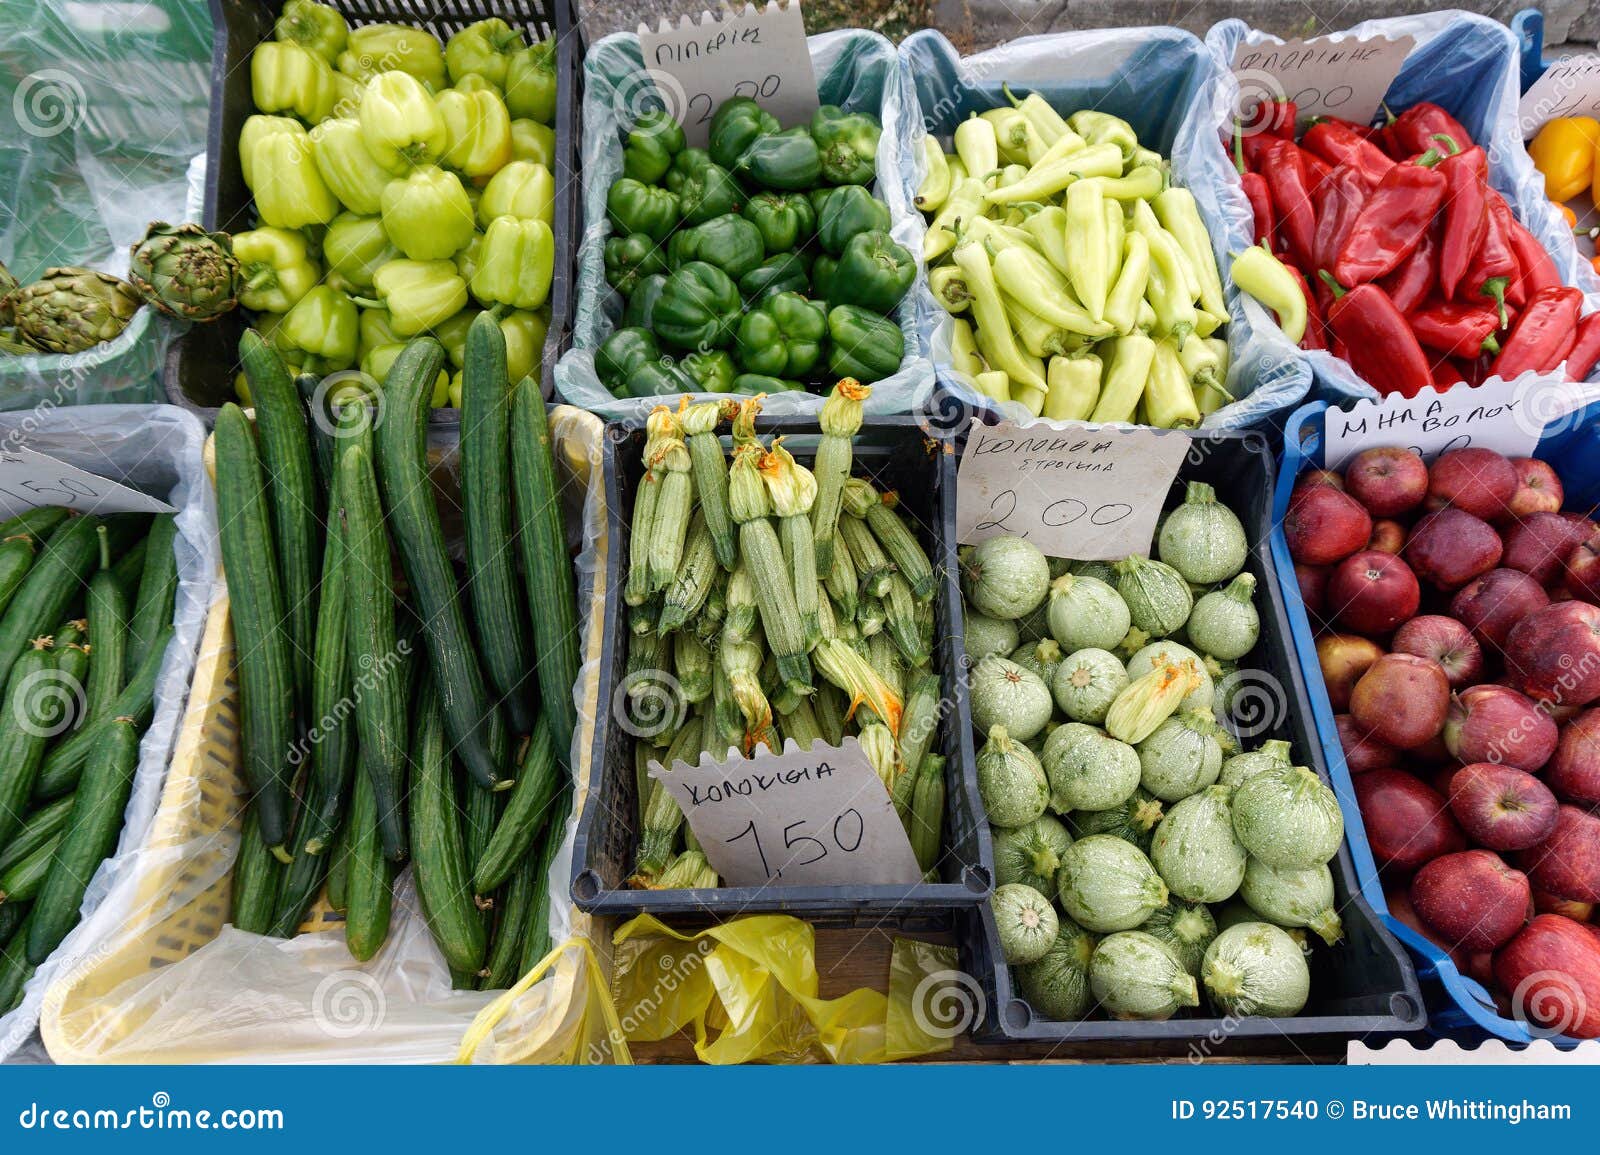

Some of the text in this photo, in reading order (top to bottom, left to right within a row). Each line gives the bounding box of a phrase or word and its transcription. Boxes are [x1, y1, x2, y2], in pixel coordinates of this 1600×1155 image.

[1341, 400, 1443, 438] ΜΗΛΑ
[1422, 400, 1520, 432] ΒΟΛΟΥ
[975, 489, 1133, 538] 2,00
[725, 808, 864, 879] 1,50
